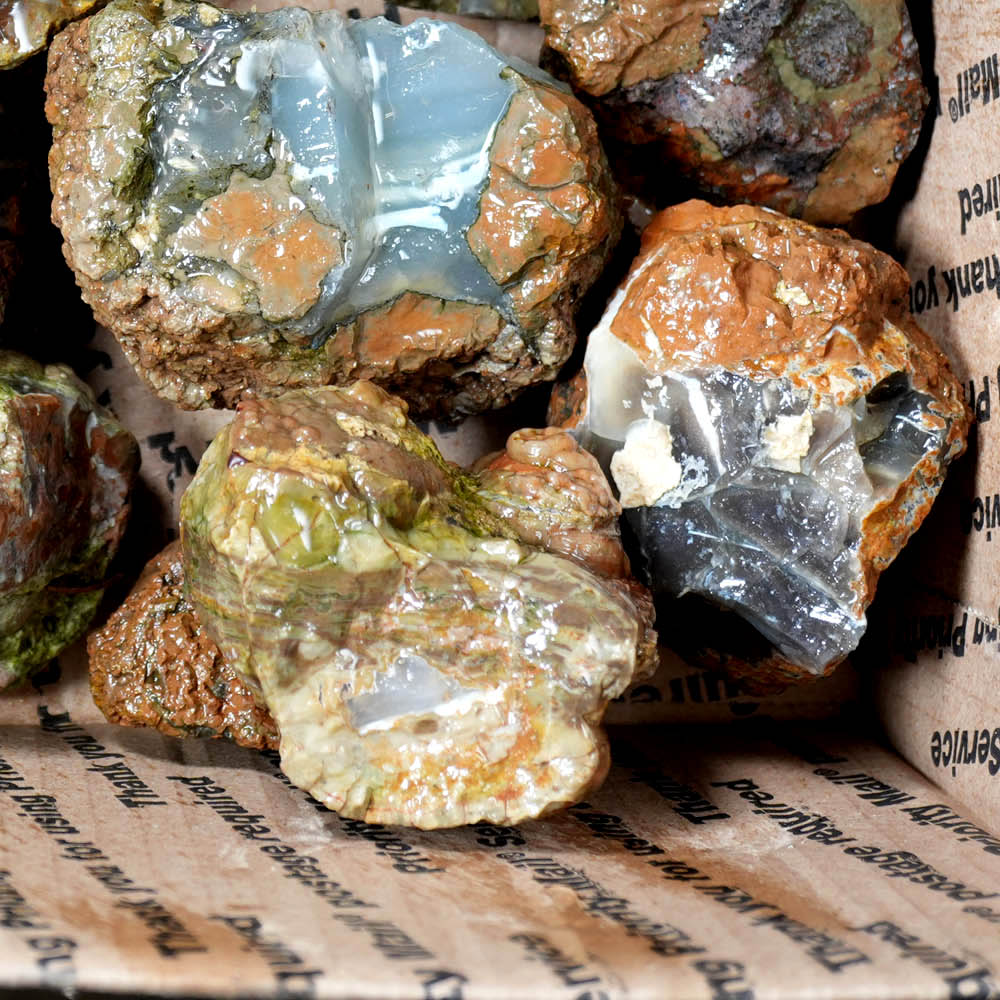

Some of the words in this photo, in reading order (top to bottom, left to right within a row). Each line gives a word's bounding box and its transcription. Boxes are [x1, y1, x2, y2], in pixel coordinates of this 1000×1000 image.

[942, 253, 1000, 313] hank
[86, 760, 168, 808] Thank
[165, 775, 282, 841] required
[710, 777, 857, 847] required
[11, 794, 81, 836] using
